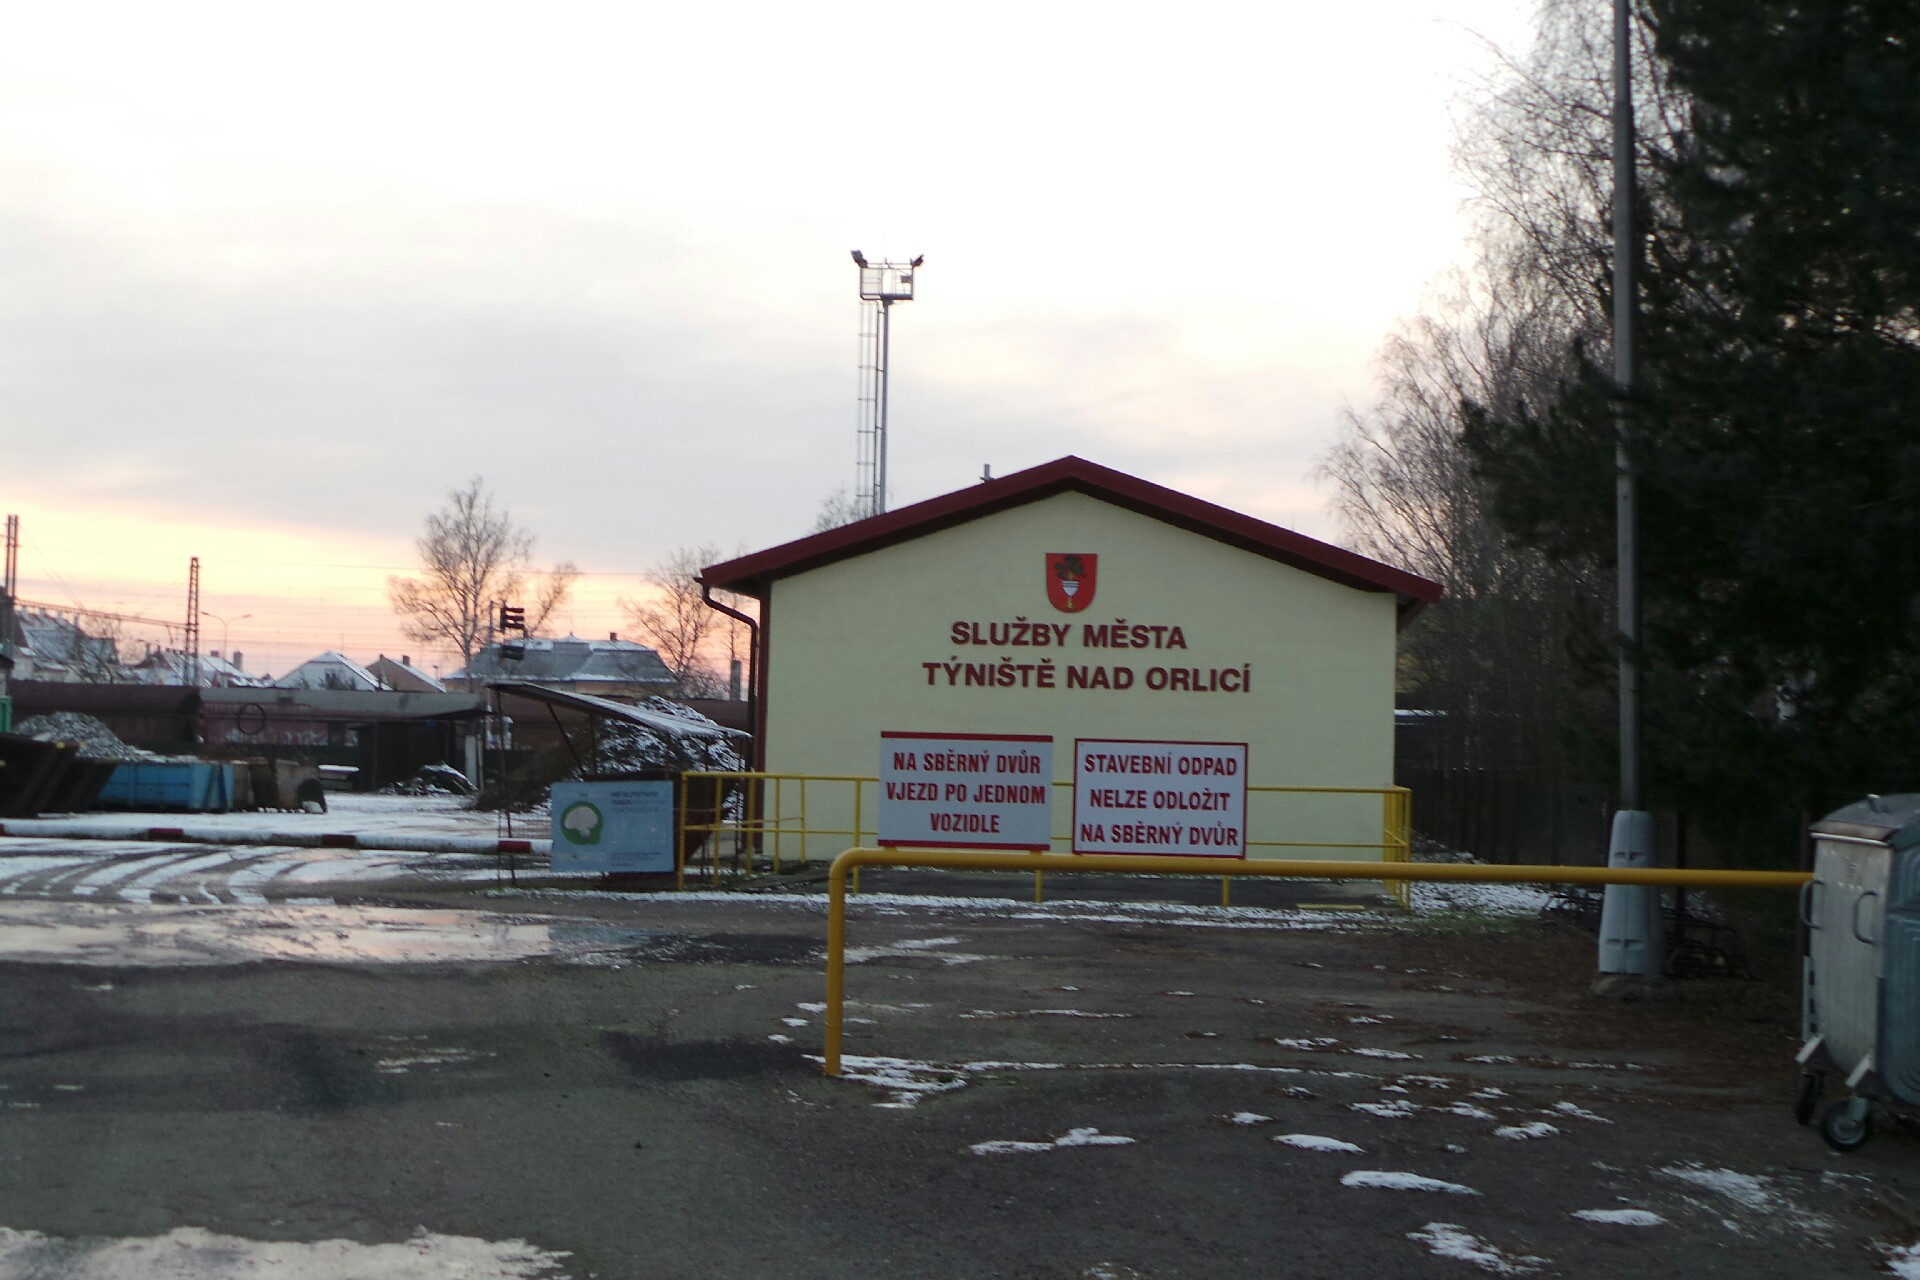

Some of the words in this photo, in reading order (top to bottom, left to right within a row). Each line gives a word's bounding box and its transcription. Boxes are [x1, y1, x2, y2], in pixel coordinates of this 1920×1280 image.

[951, 617, 1070, 647] SLUŽBY
[1083, 619, 1187, 649] MĚSTA
[923, 656, 1055, 688] TÝNIŠTĚ
[1068, 666, 1134, 689] NAD
[1146, 664, 1251, 692] ORLICÍ
[893, 752, 916, 770] NA
[923, 749, 989, 773] SBĚRNÝ
[996, 750, 1041, 774] DVŮR
[1084, 751, 1172, 775] STAVEBNÍ
[1178, 757, 1237, 776] ODPAD
[887, 783, 938, 801] VJEZD
[945, 783, 968, 802] PO
[973, 785, 1046, 804] JEDNOM
[1090, 790, 1147, 808] NELZE
[1153, 787, 1230, 811] ODLOŽIT
[930, 814, 1000, 833] VOZIDLE
[1080, 823, 1105, 842] NA
[1111, 821, 1182, 844] SBĚRNÝ
[1189, 821, 1238, 846] DVŮR
